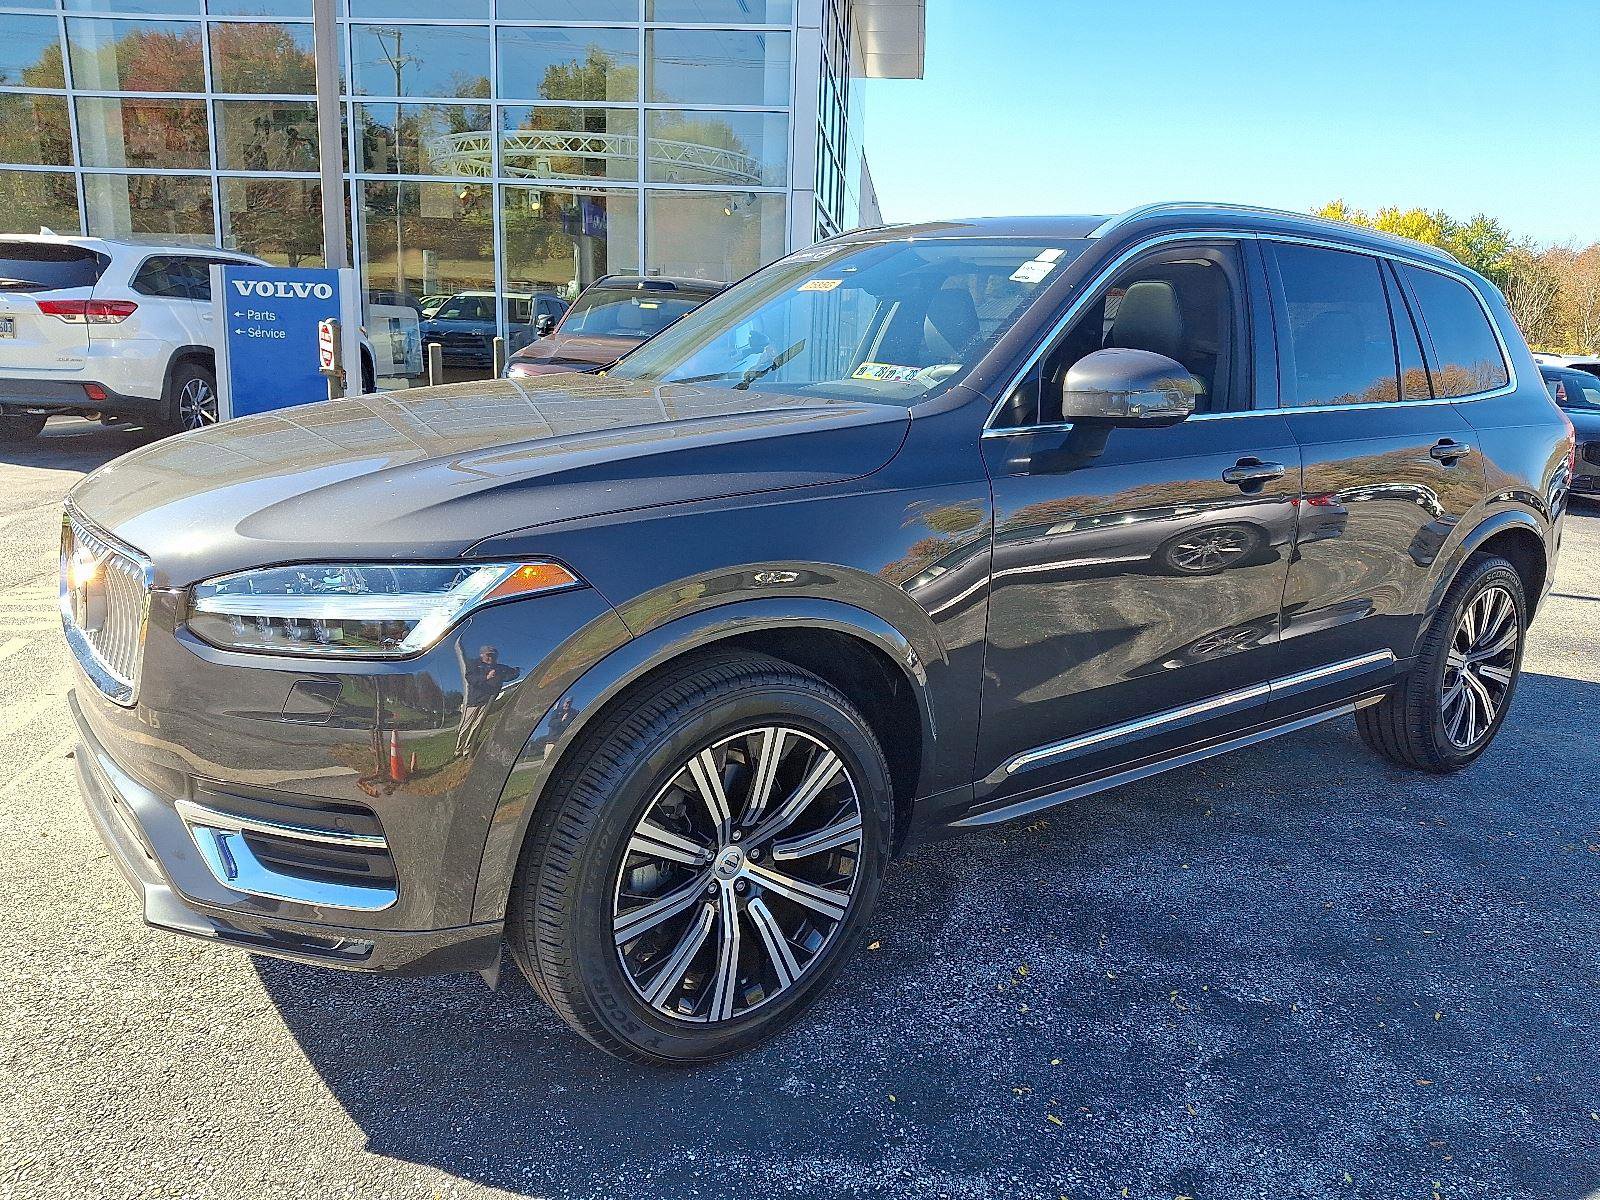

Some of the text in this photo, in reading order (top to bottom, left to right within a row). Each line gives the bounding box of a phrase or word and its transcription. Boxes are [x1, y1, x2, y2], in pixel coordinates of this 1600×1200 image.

[232, 280, 333, 299] VOLVO
[247, 309, 276, 321] Parts
[247, 327, 286, 339] Service
